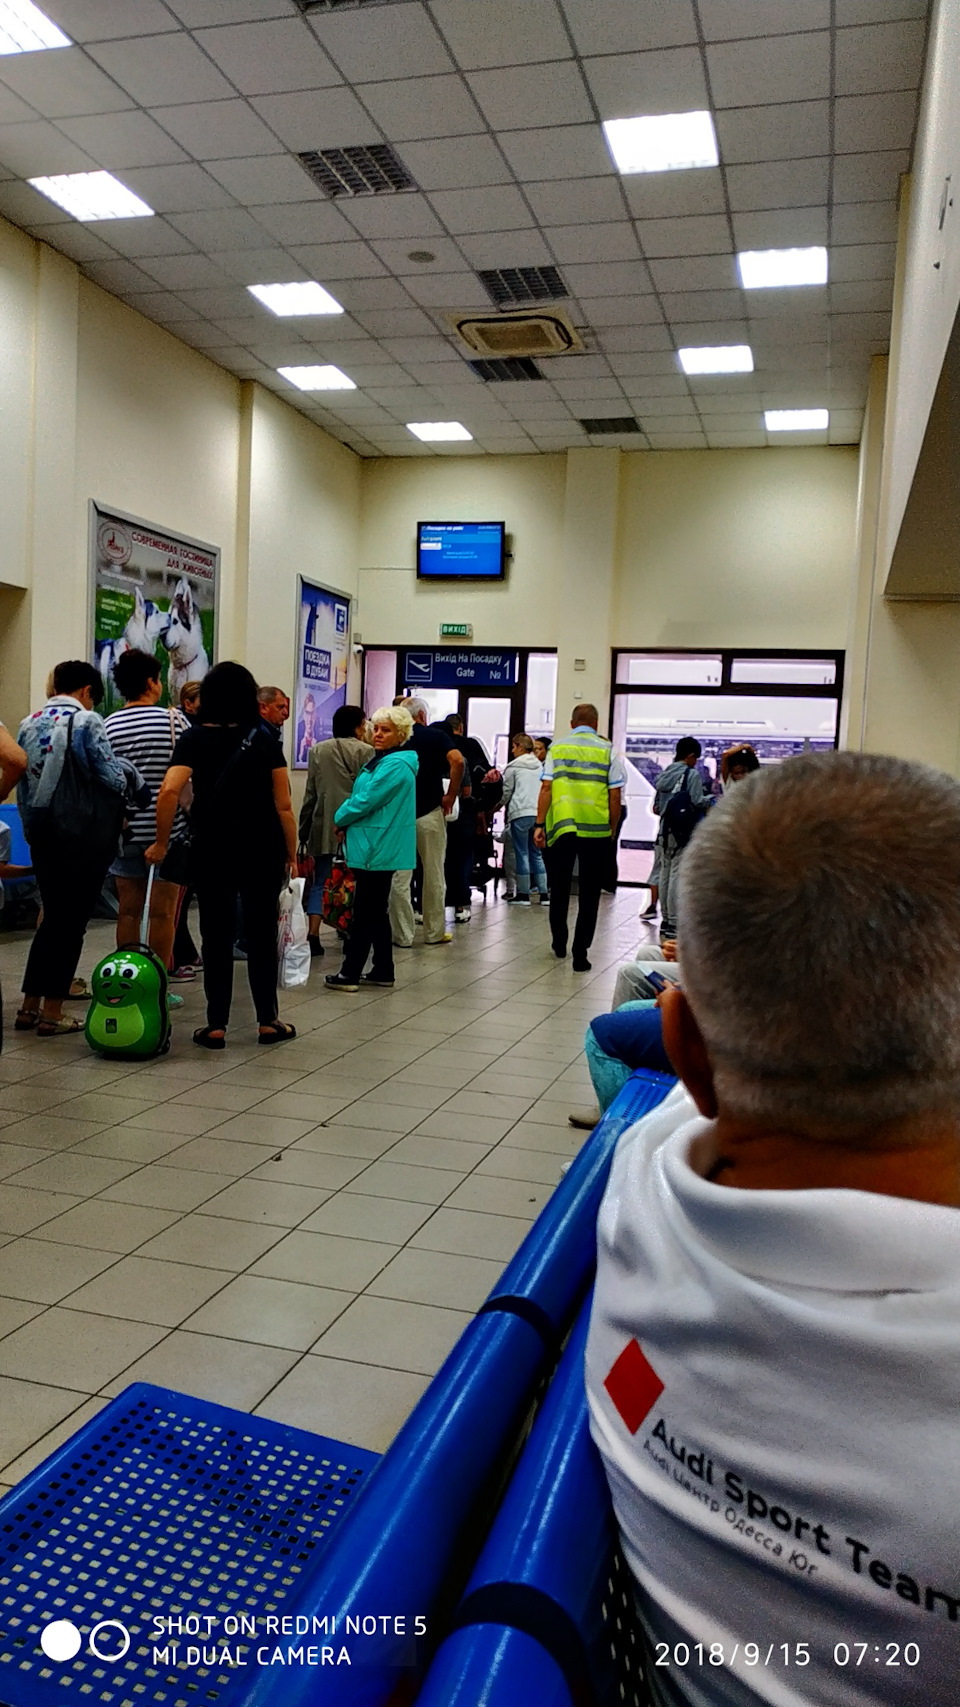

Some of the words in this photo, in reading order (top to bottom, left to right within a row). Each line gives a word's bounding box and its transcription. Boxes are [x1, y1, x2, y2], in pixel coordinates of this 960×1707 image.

[132, 532, 178, 556] СОВРЕМЕННАЯ
[180, 548, 213, 567] ГОСТИНИЦА
[167, 558, 180, 570] ДЛЯ
[442, 624, 467, 634] ВИХІД
[305, 648, 330, 666] ПОЕЗДКА
[434, 653, 456, 664] Вихід
[458, 653, 468, 662] На
[470, 654, 502, 665] Посадку
[306, 664, 311, 675] В
[456, 667, 475, 678] Gate
[489, 670, 502, 680] №
[503, 660, 510, 680] 1
[651, 1418, 714, 1486] Audi
[724, 1471, 831, 1556] Sport
[672, 1467, 720, 1515] Центр
[724, 1506, 783, 1558] Одесса
[787, 1549, 819, 1577] Юг
